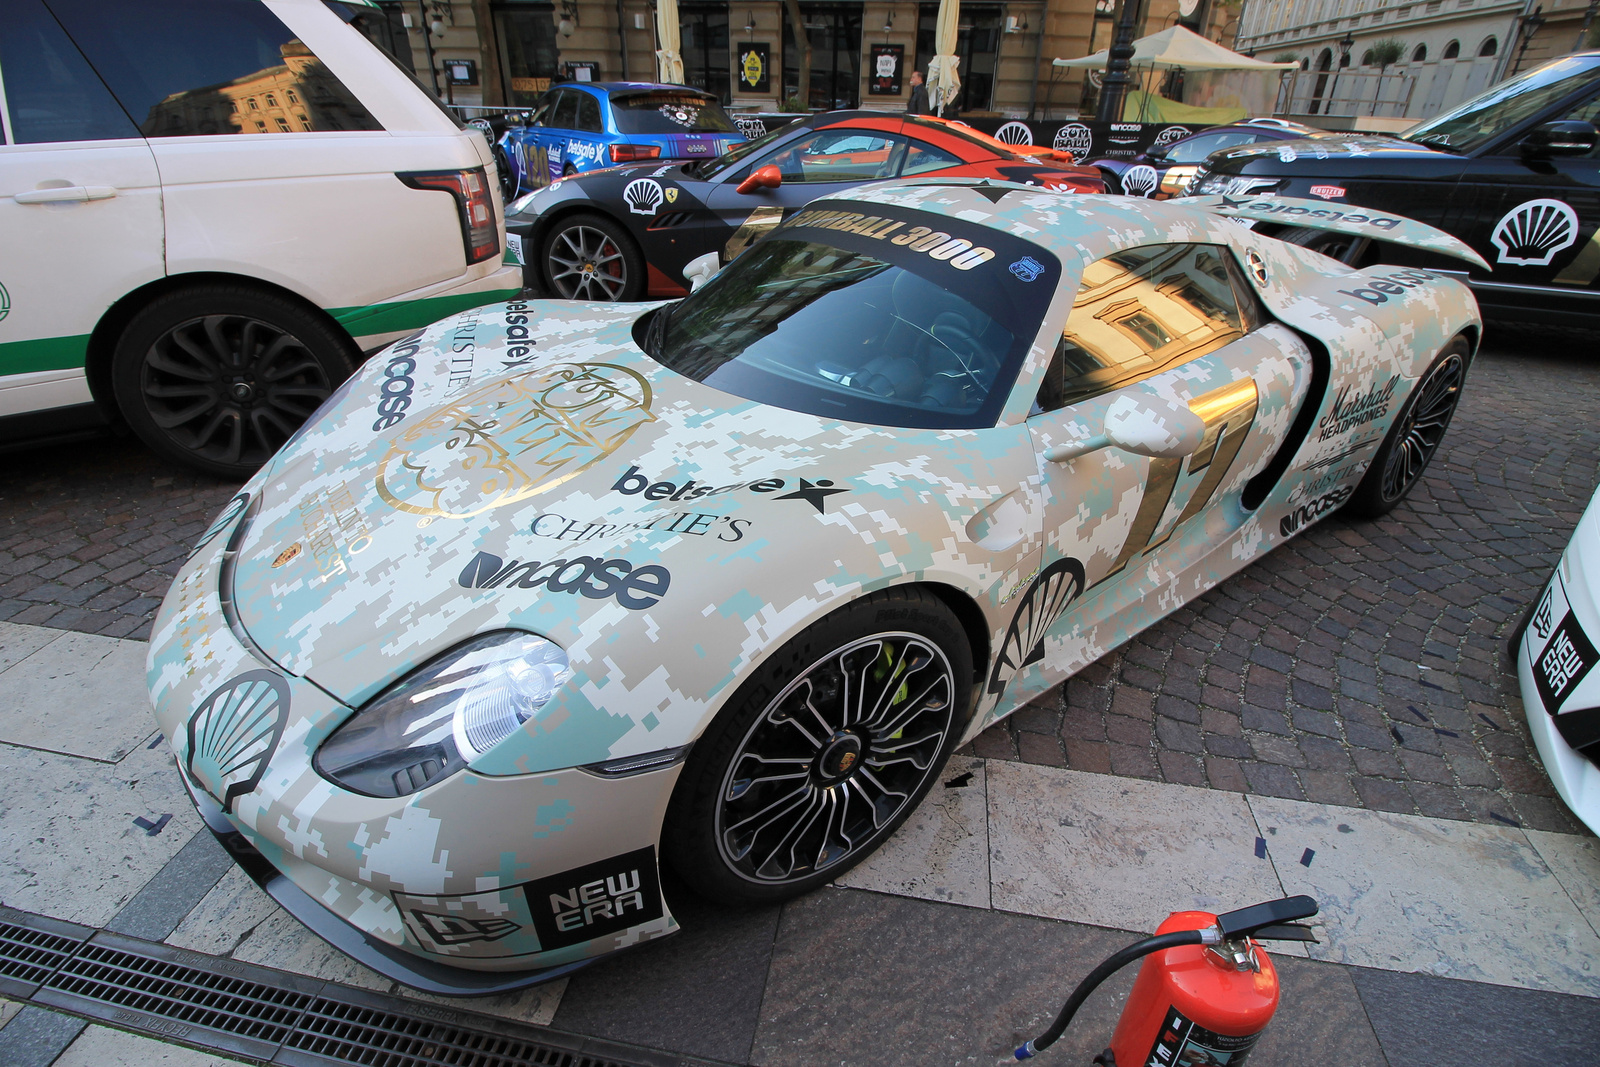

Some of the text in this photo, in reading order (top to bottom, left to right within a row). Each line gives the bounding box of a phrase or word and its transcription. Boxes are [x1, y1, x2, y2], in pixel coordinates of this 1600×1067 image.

[1110, 123, 1142, 131] incase
[524, 144, 551, 187] 120
[567, 139, 596, 160] betsafe
[1249, 200, 1402, 232] betsafe
[783, 210, 906, 240] GUMBALL
[891, 226, 996, 271] 3000
[1318, 403, 1389, 443] HEADPHONES
[1319, 373, 1401, 429] Marshall
[1279, 485, 1354, 538] incase
[298, 494, 347, 582] BUCHAREST
[345, 524, 371, 554] TO
[458, 550, 671, 611] incase
[1541, 649, 1568, 698] ERA
[1552, 629, 1584, 679] NEW
[549, 869, 641, 915] NEW
[554, 891, 644, 932] ERA
[142, 1016, 193, 1038] RECYFIX
